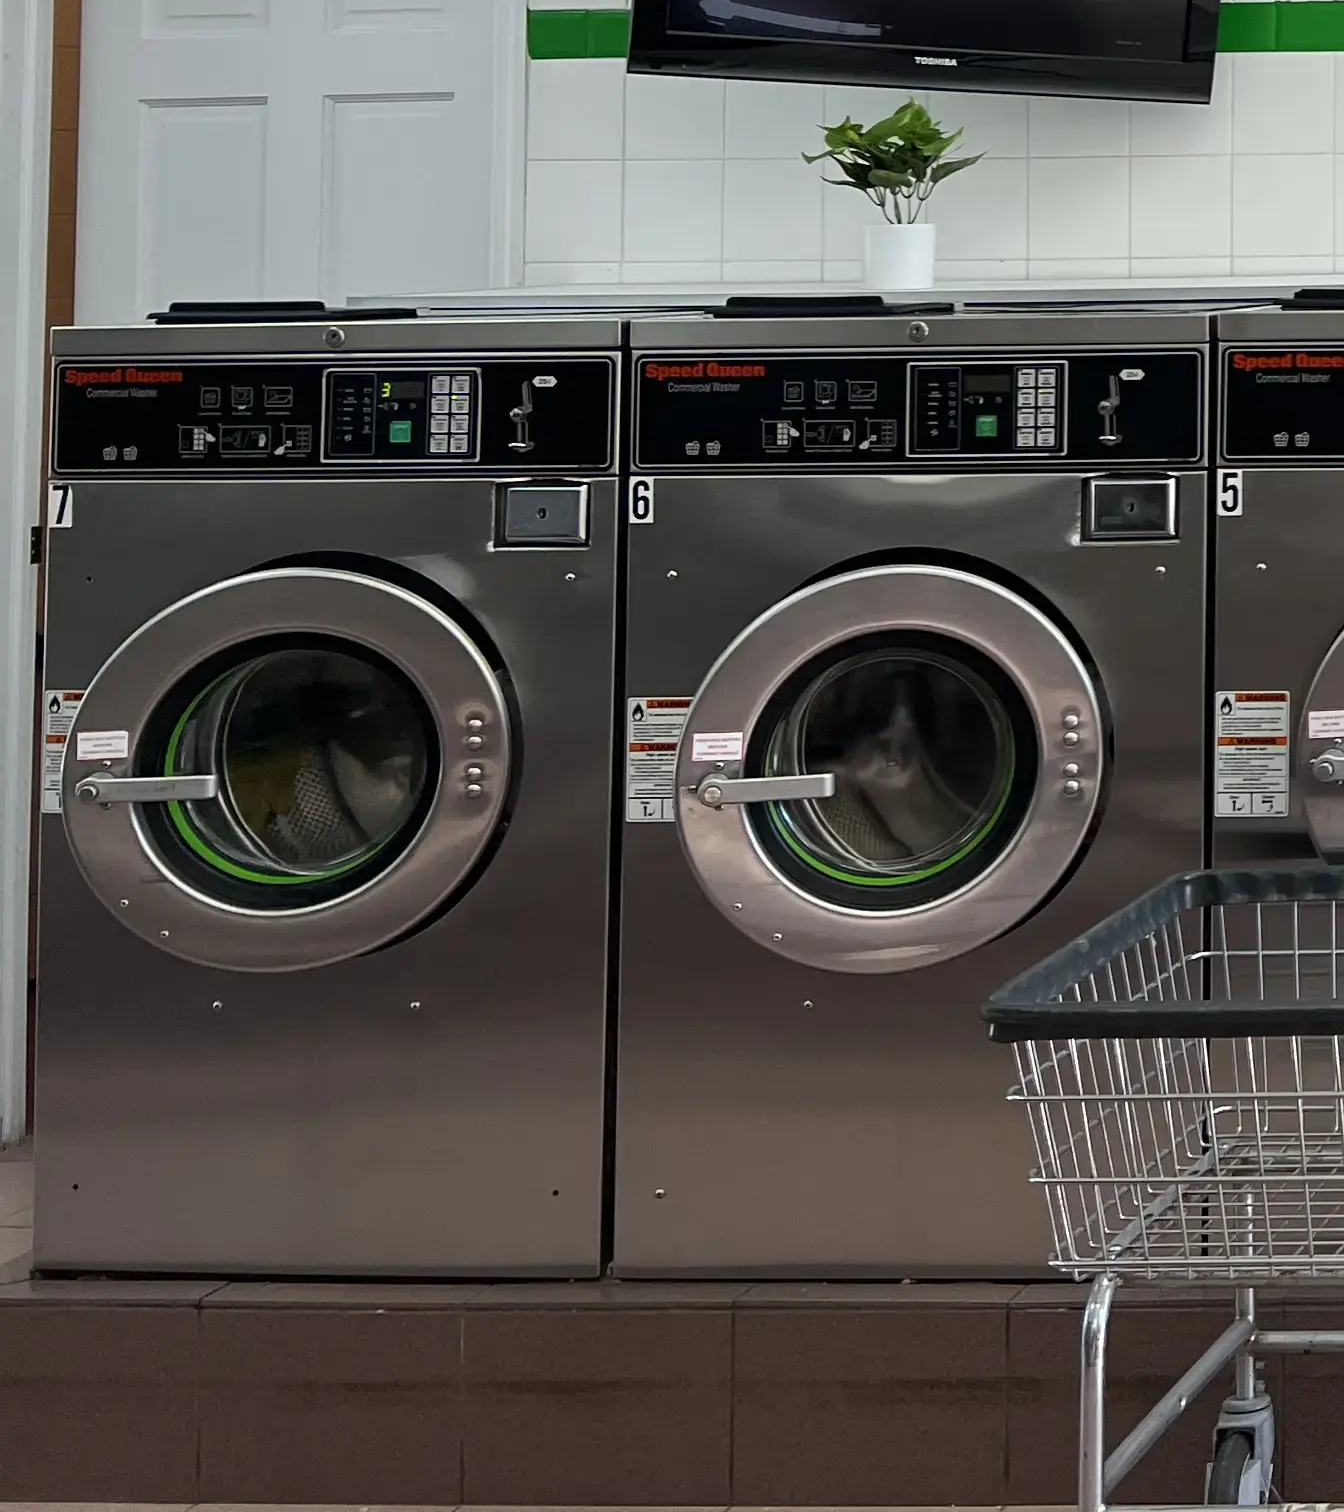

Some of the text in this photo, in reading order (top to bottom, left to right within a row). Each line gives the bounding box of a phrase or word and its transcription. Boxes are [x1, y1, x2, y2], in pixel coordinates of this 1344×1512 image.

[914, 56, 957, 66] TOSHIBA
[645, 362, 766, 381] Speed Queen
[1233, 354, 1292, 371] Speed
[65, 368, 183, 386] Speed Queen
[381, 382, 391, 397] 3
[632, 480, 650, 520] 6
[1221, 473, 1239, 513] 5
[52, 485, 69, 525] 7
